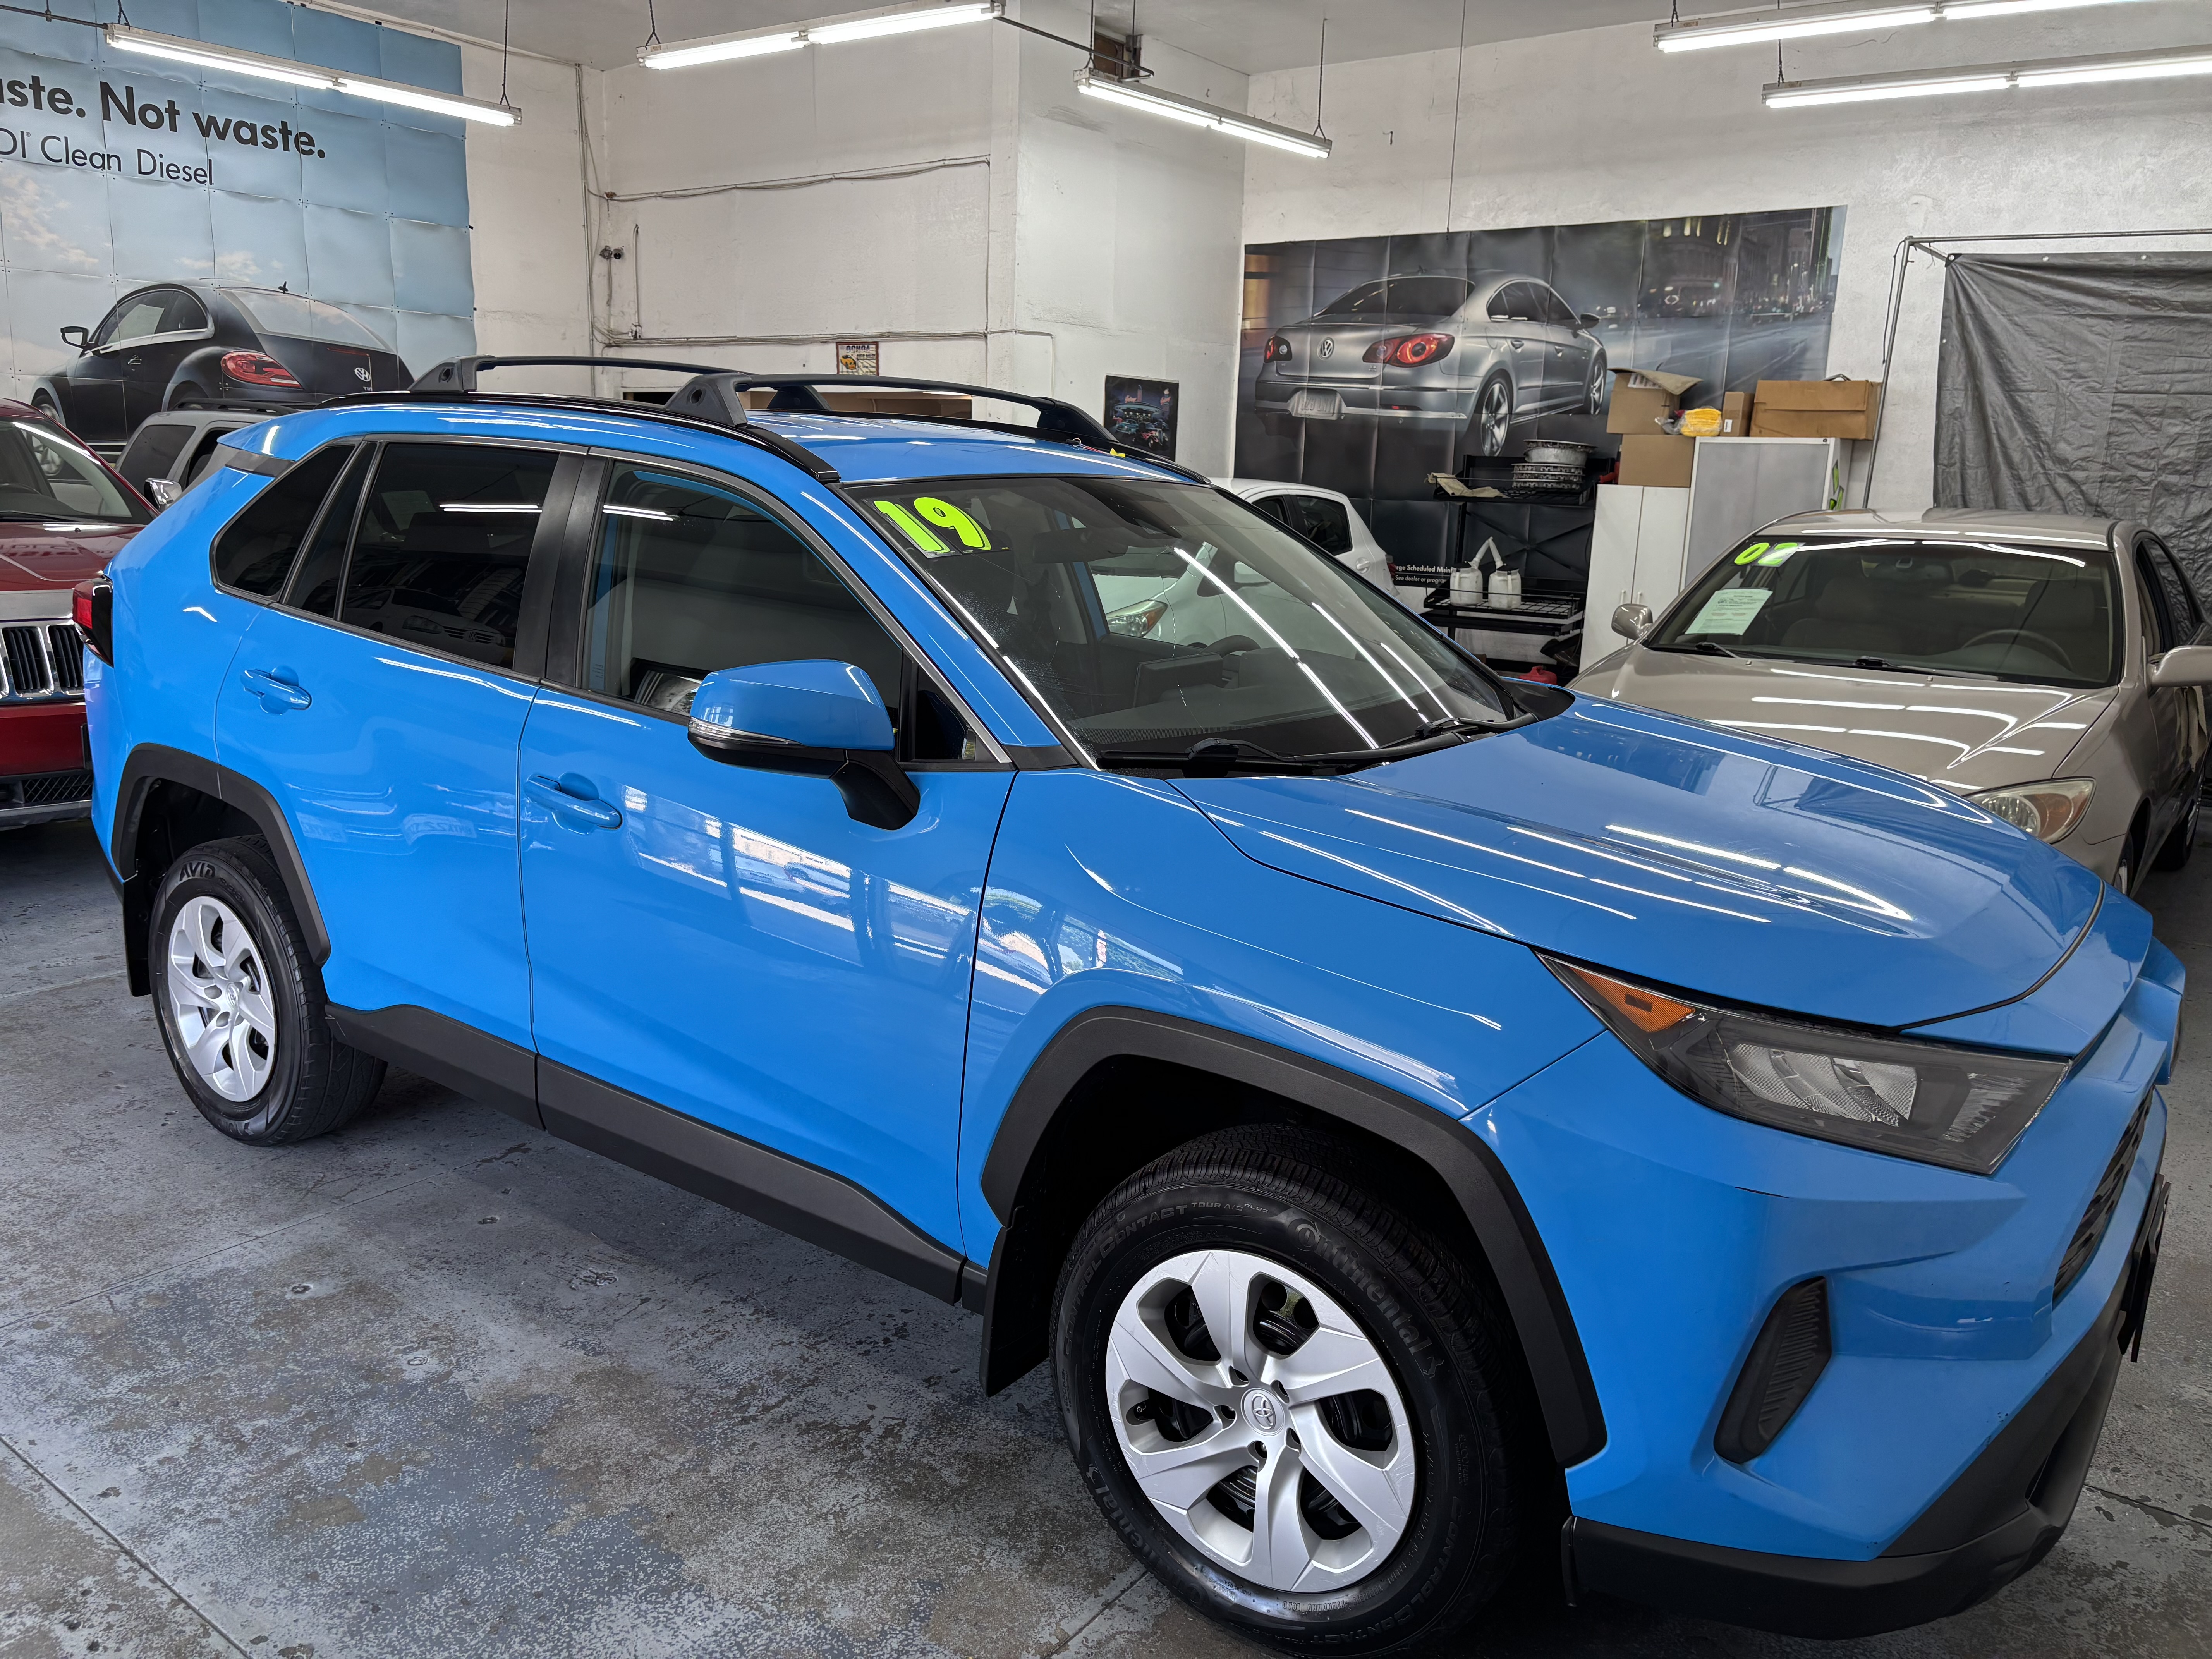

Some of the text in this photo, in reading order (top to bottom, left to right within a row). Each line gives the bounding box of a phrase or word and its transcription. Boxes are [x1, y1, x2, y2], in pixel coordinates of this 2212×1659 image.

[0, 75, 325, 159] ste. Not waste.
[41, 136, 121, 172] Clean
[137, 149, 213, 185] Diesel
[874, 497, 991, 553] 19
[1734, 542, 1798, 565] 02
[1407, 564, 1436, 572] Scheduled
[179, 862, 216, 882] AVID
[1223, 1203, 1243, 1212] A/S
[1243, 1202, 1269, 1213] PLUS
[1288, 1218, 1433, 1355] Continental
[1282, 1601, 1301, 1611] LOAD
[1307, 1600, 1346, 1612] STANDARD
